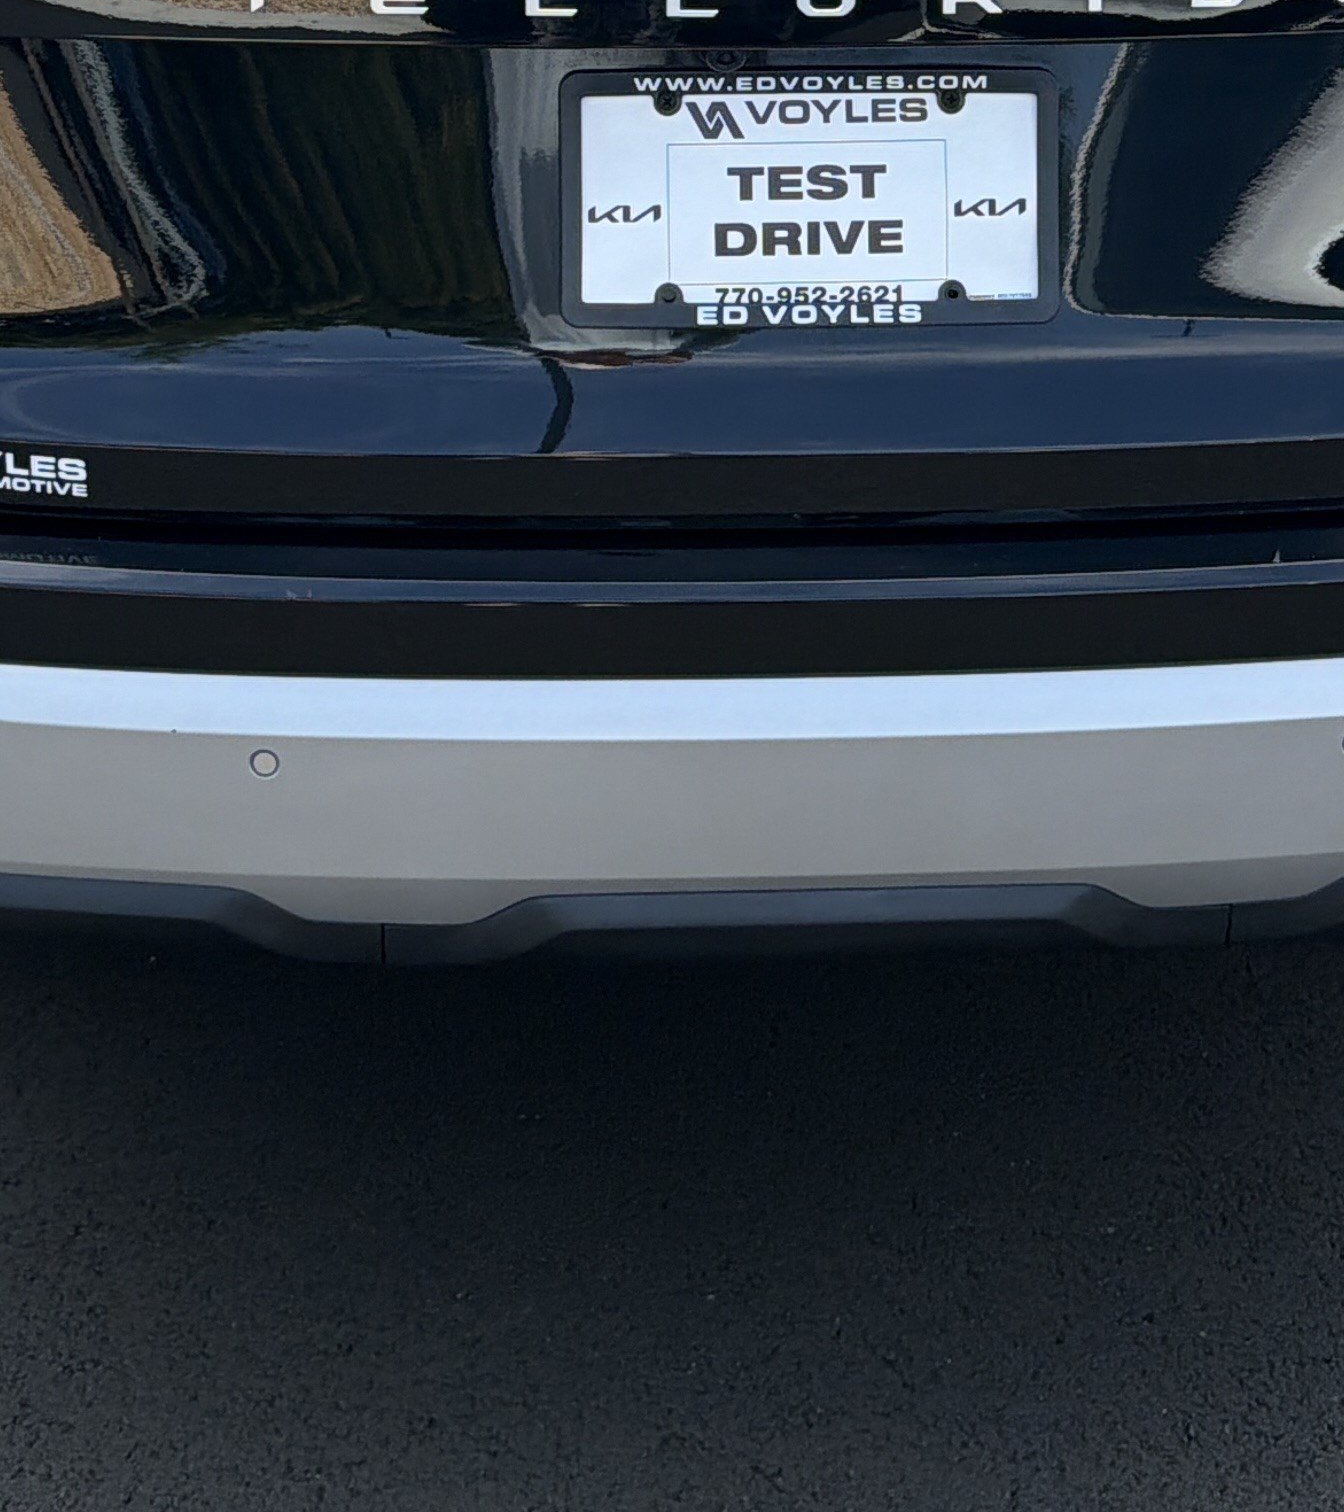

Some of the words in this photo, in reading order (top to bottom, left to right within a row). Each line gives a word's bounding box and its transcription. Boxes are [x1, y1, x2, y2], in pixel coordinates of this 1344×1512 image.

[633, 74, 988, 92] WWW.EDVOYLES.COM
[745, 98, 928, 125] VOYLES
[726, 163, 887, 201] TEST
[587, 203, 661, 224] KIA
[953, 197, 1027, 219] KIA
[713, 219, 904, 257] DRIVE
[714, 284, 903, 304] 770-952-2621
[696, 305, 749, 326] ED
[761, 303, 923, 325] VOYLES
